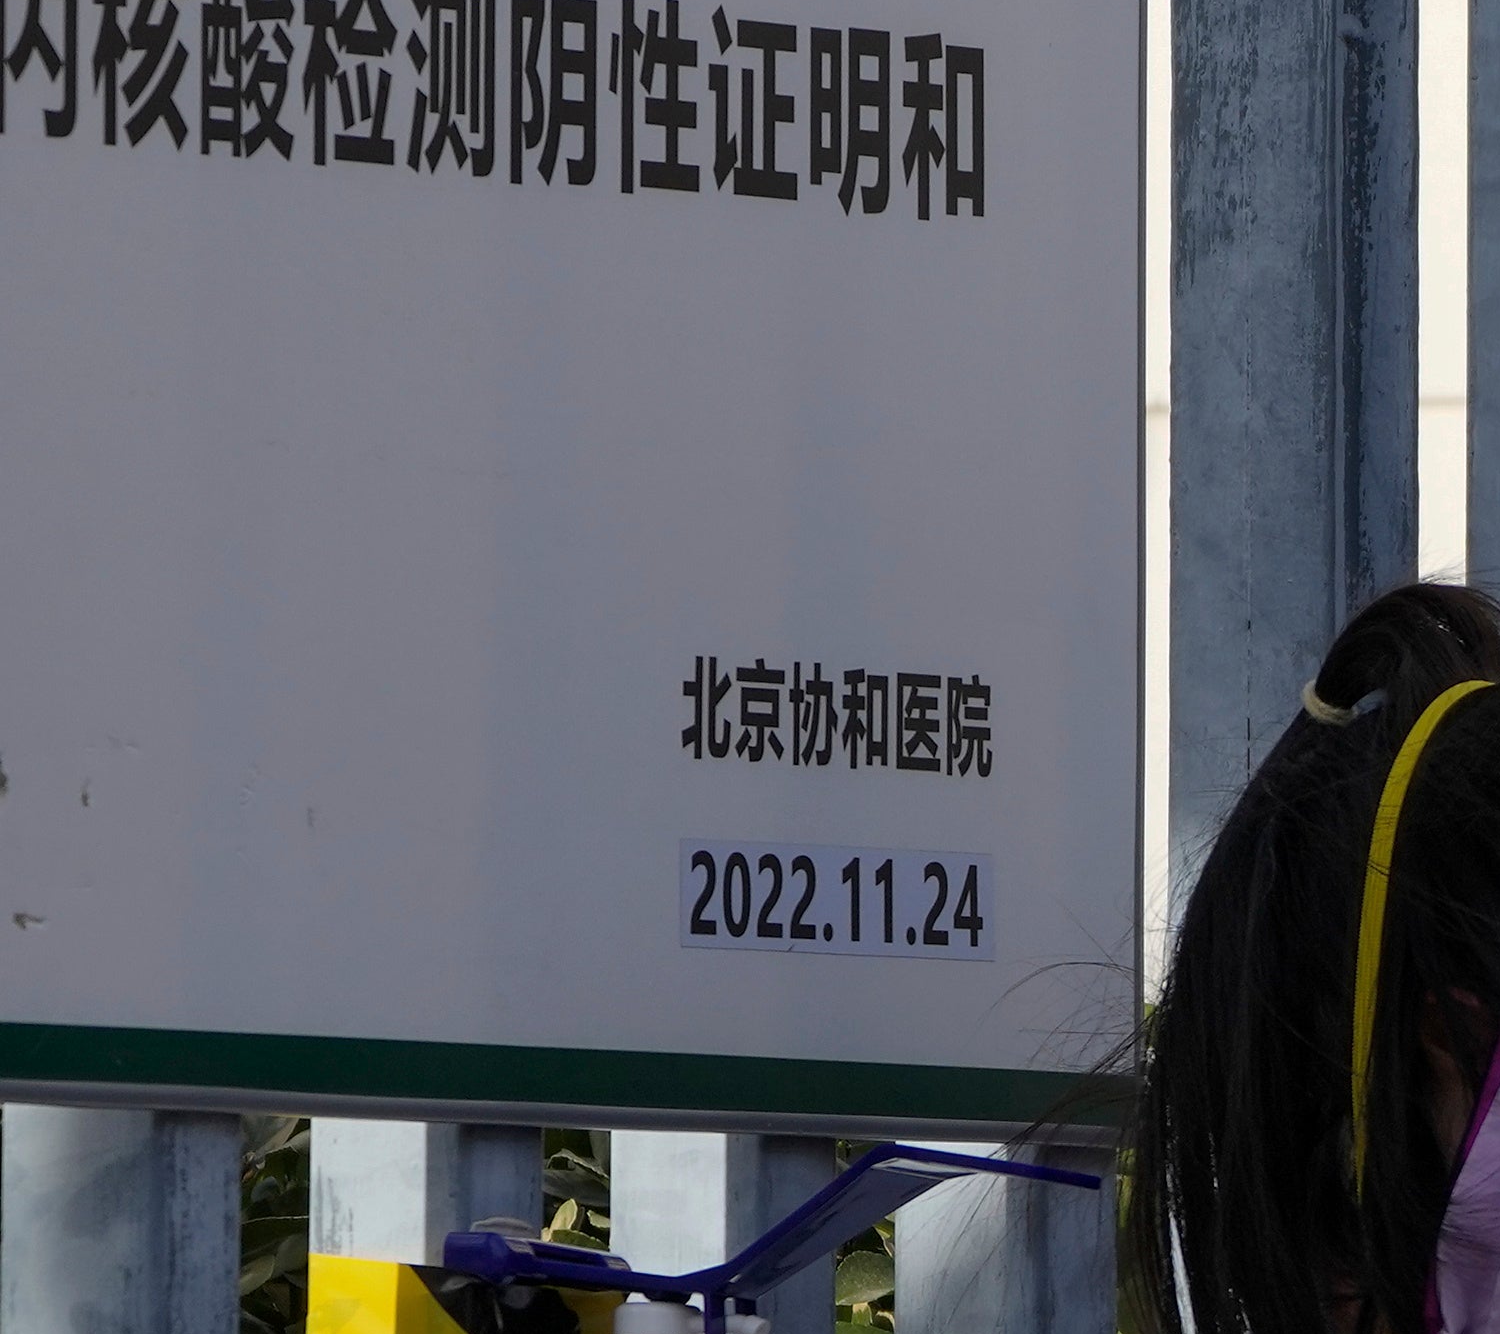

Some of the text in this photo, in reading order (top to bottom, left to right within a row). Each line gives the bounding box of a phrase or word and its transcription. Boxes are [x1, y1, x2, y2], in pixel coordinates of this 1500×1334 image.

[681, 655, 993, 778] 北京协和医院
[690, 849, 983, 947] 2022.11.24
